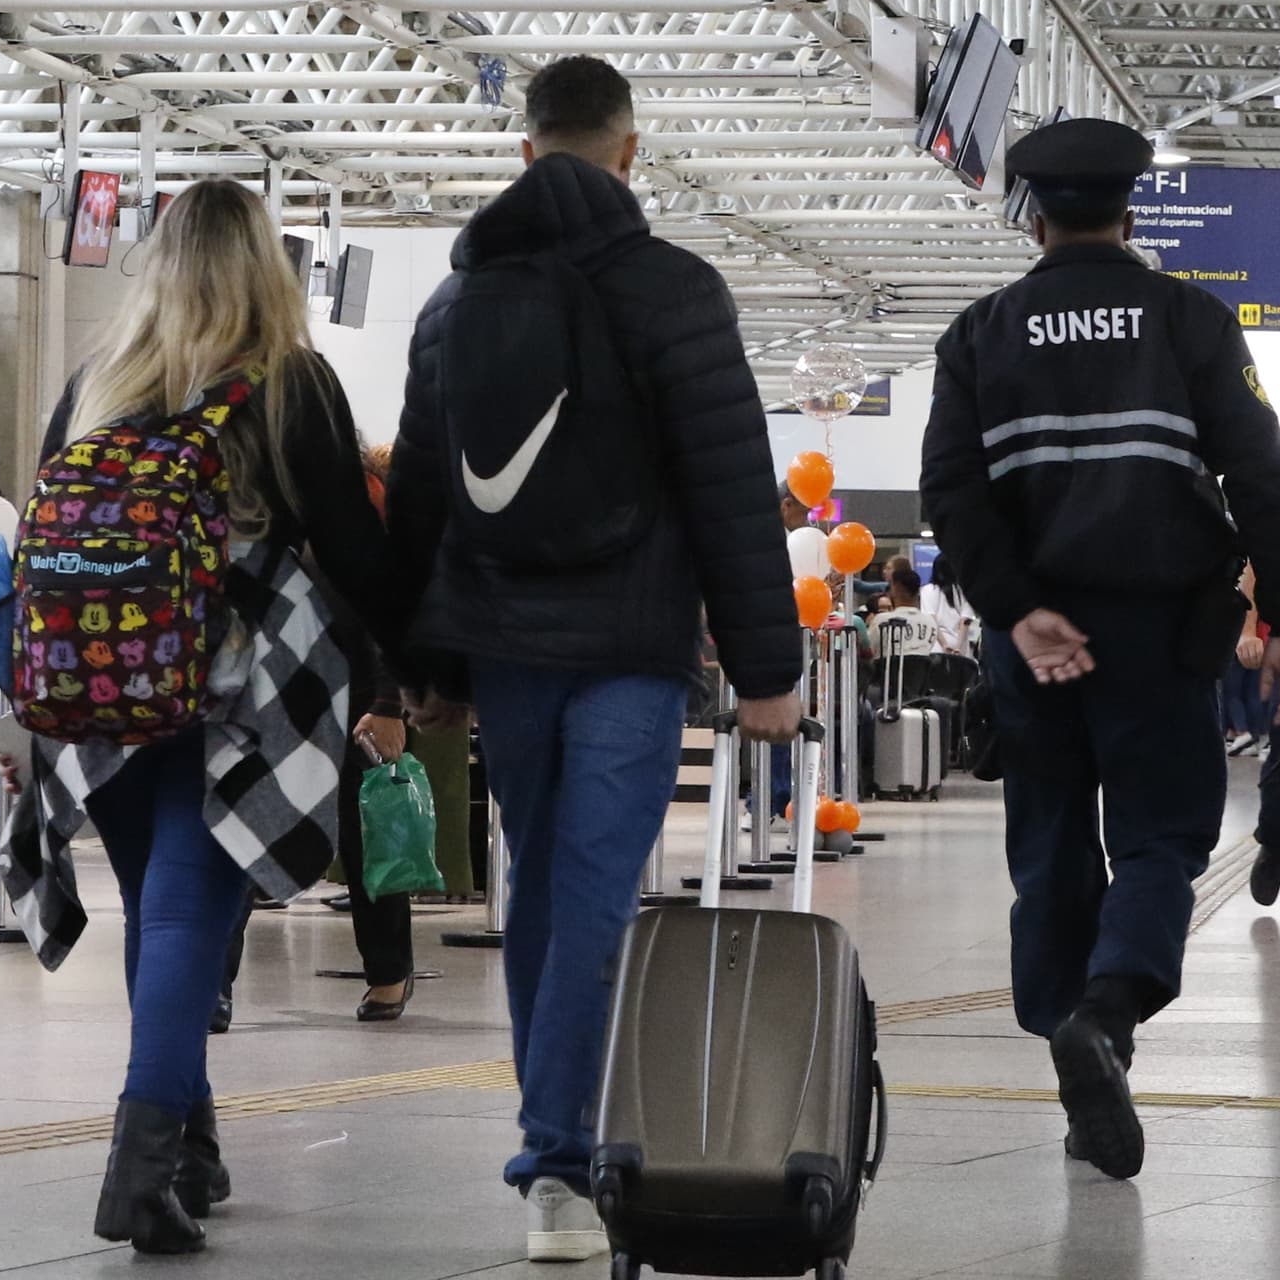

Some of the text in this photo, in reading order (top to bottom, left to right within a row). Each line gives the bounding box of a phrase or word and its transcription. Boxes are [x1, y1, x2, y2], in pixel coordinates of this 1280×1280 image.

[1155, 171, 1187, 194] F-I
[1128, 204, 1233, 217] arque internacional
[1134, 218, 1204, 228] tional departures
[1131, 236, 1180, 249] mbarque
[1192, 270, 1239, 281] Terminal
[1240, 271, 1248, 281] 2
[1027, 307, 1143, 346] SUNSET
[30, 554, 57, 570] Walt
